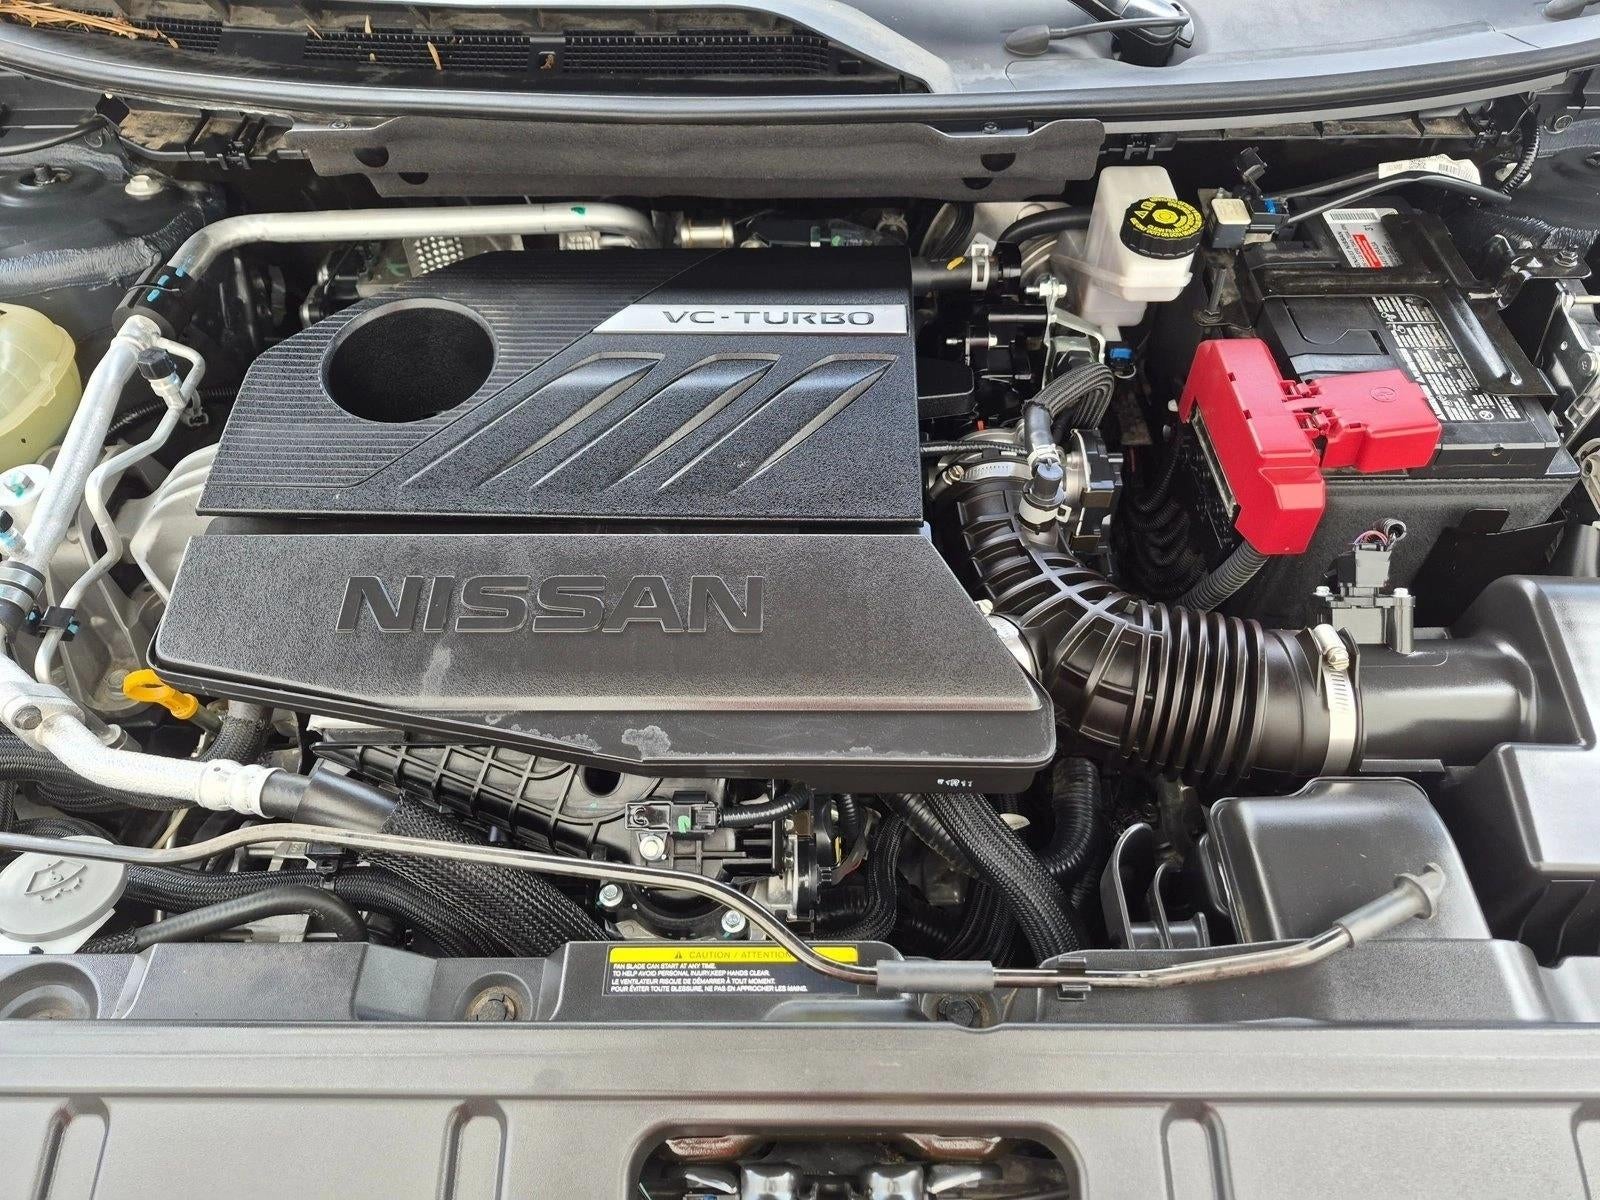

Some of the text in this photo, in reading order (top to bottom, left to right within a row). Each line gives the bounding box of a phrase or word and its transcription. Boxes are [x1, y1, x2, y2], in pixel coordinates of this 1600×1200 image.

[662, 310, 875, 326] VC-TURBO
[334, 575, 764, 634] NISSAN
[689, 951, 730, 959] CAUTION
[726, 977, 731, 985] À
